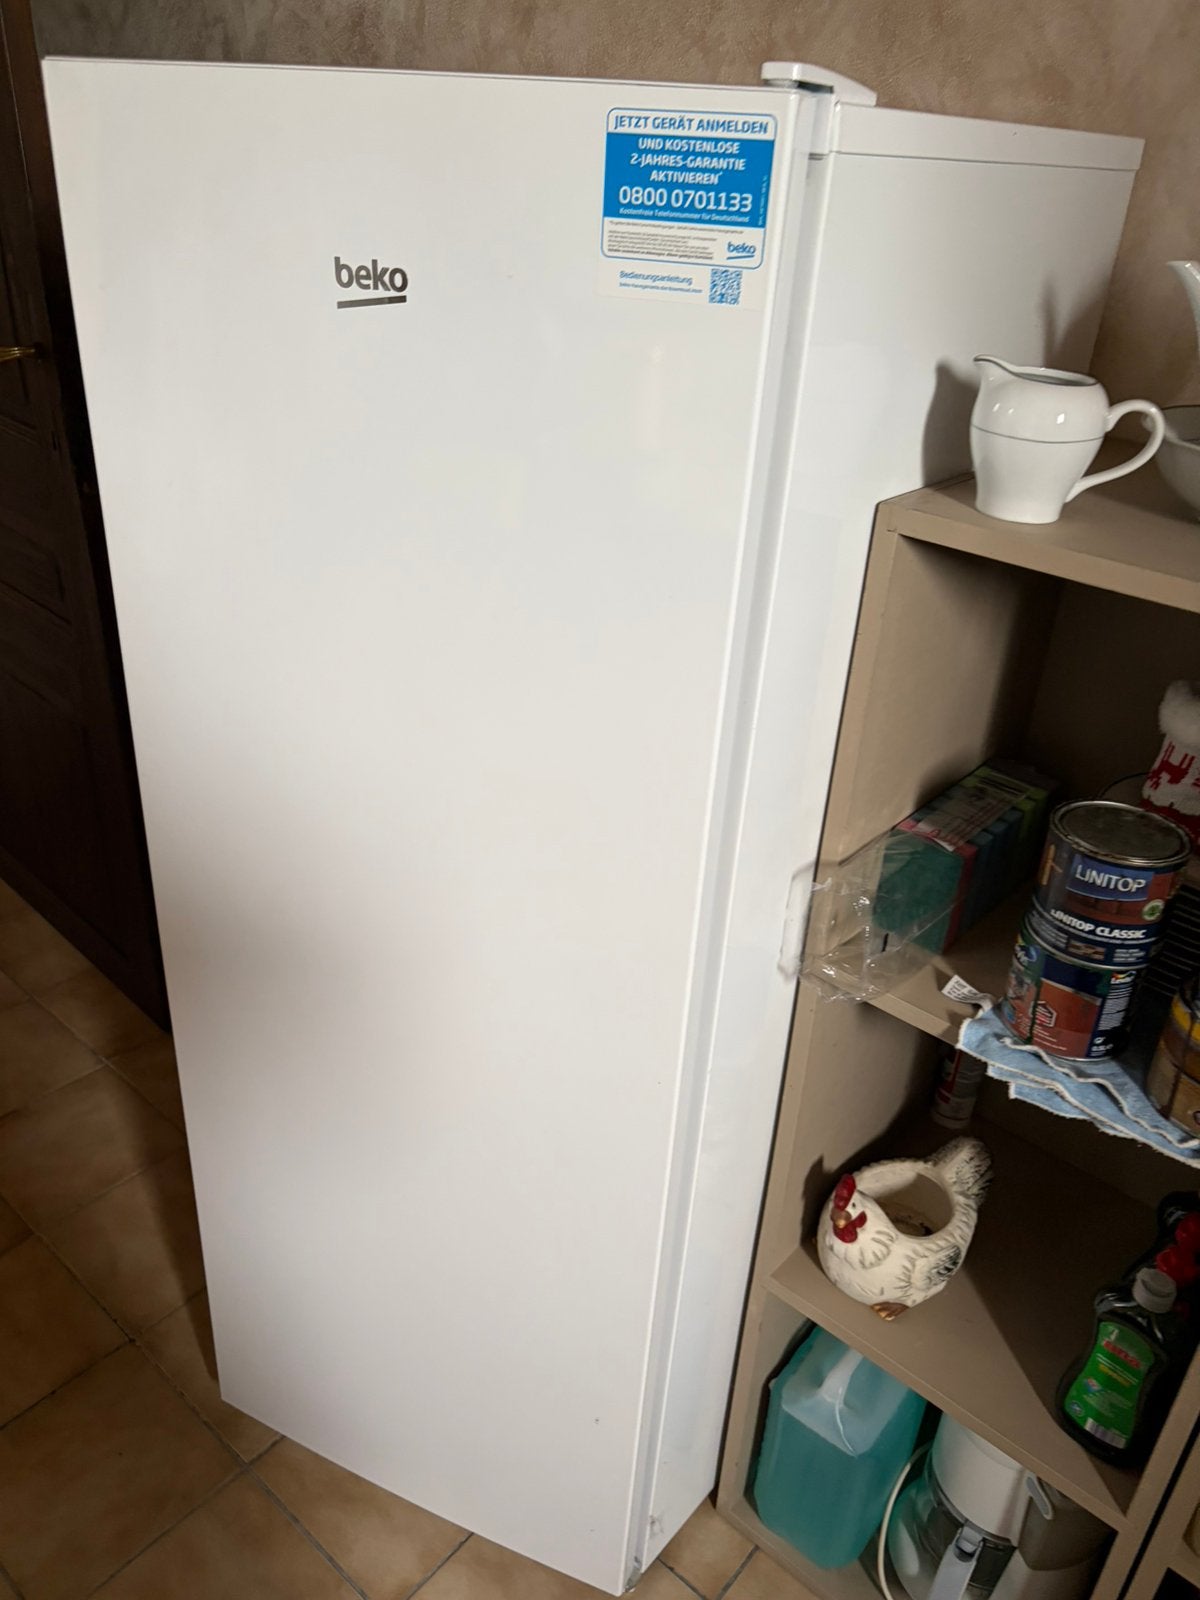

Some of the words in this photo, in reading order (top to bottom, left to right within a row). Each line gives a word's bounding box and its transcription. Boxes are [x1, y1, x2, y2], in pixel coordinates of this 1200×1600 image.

[614, 115, 651, 131] JETZT
[652, 115, 695, 132] GERÄT
[696, 117, 769, 134] ANMELDEN
[638, 137, 664, 151] UND
[665, 138, 741, 154] KOSTENLOSE
[630, 152, 747, 171] 2-JAHRES-GARANTIE
[618, 185, 668, 207] 0800
[670, 188, 753, 213] 0701133
[655, 210, 701, 220] Telefonnummer
[711, 214, 750, 223] Deutschland
[727, 241, 756, 254] beko
[334, 256, 408, 293] beko
[619, 270, 693, 286] Bedienungsanleitung
[1074, 863, 1147, 894] LINITOP
[1050, 908, 1096, 933] LINITOP
[1096, 926, 1147, 940] CLASSIC
